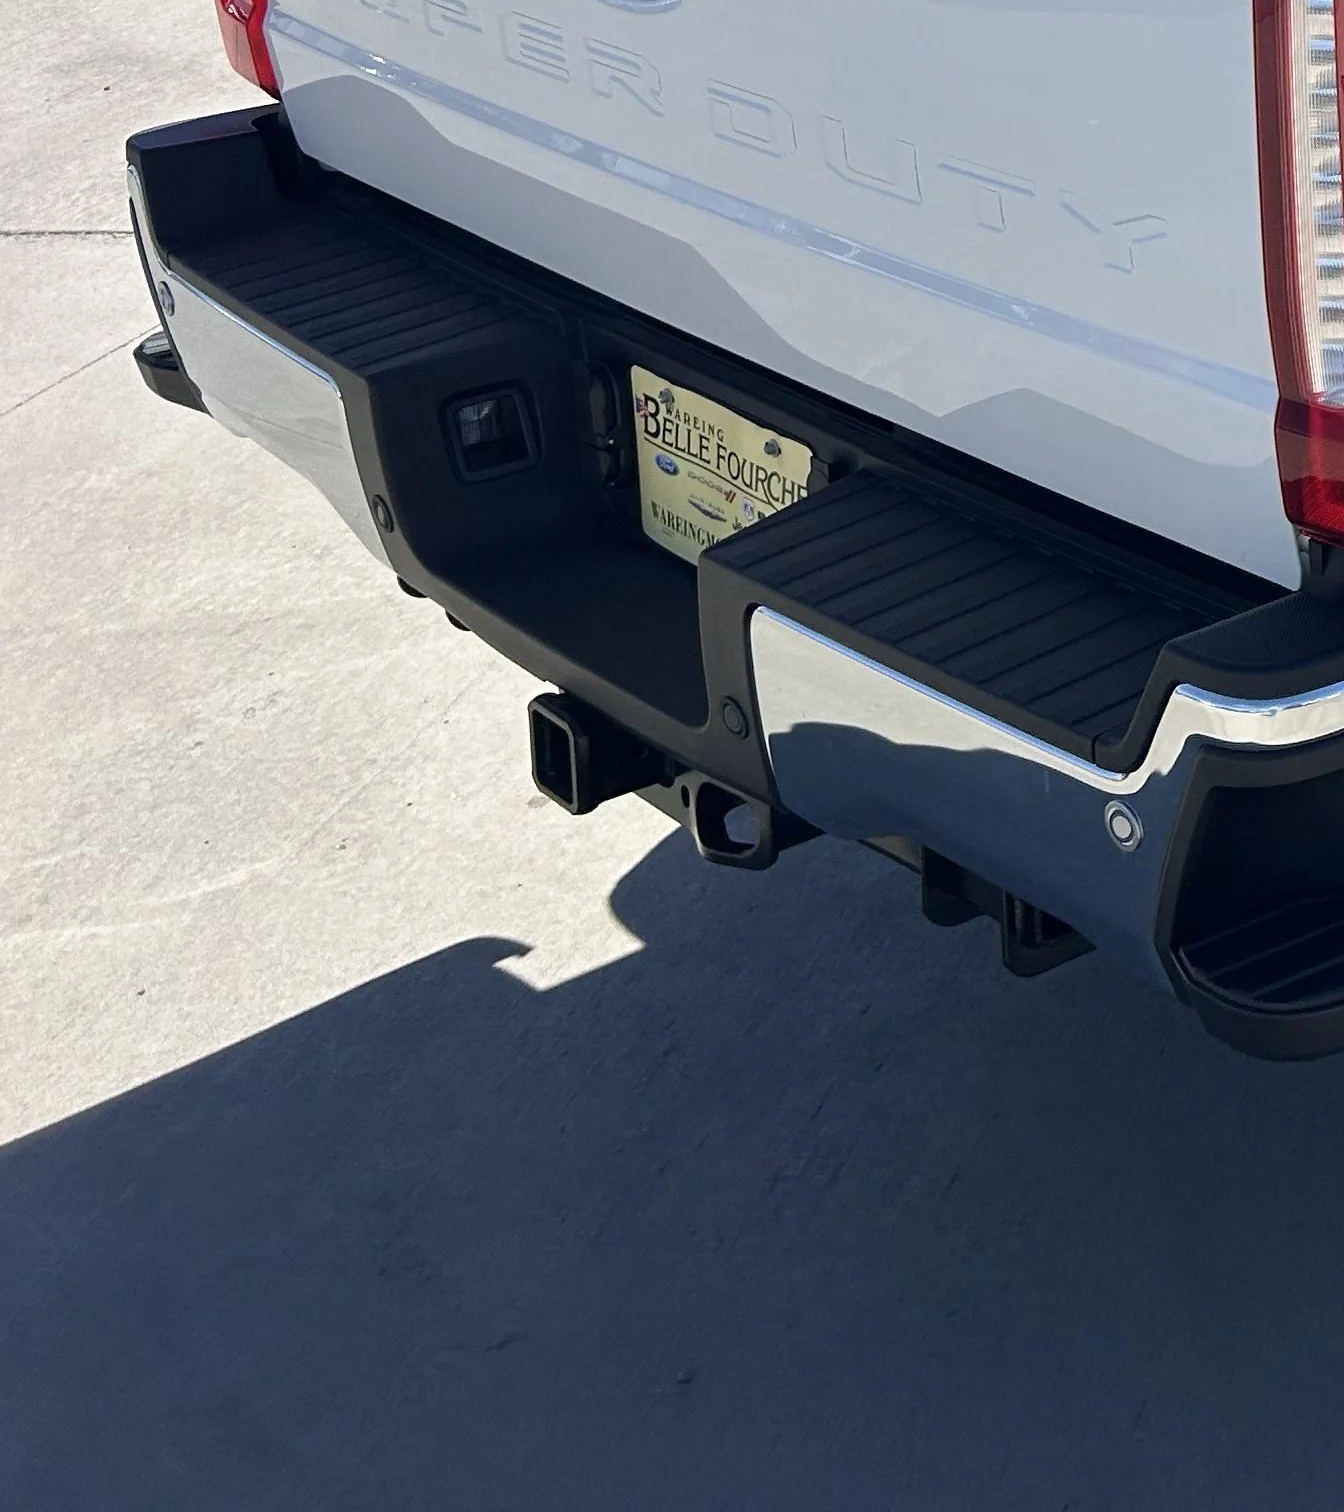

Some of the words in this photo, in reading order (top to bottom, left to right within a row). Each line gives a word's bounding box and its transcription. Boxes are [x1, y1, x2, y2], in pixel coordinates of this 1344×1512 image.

[705, 76, 1171, 276] DUTY
[643, 392, 711, 465] BELLE
[664, 403, 725, 442] WAREING
